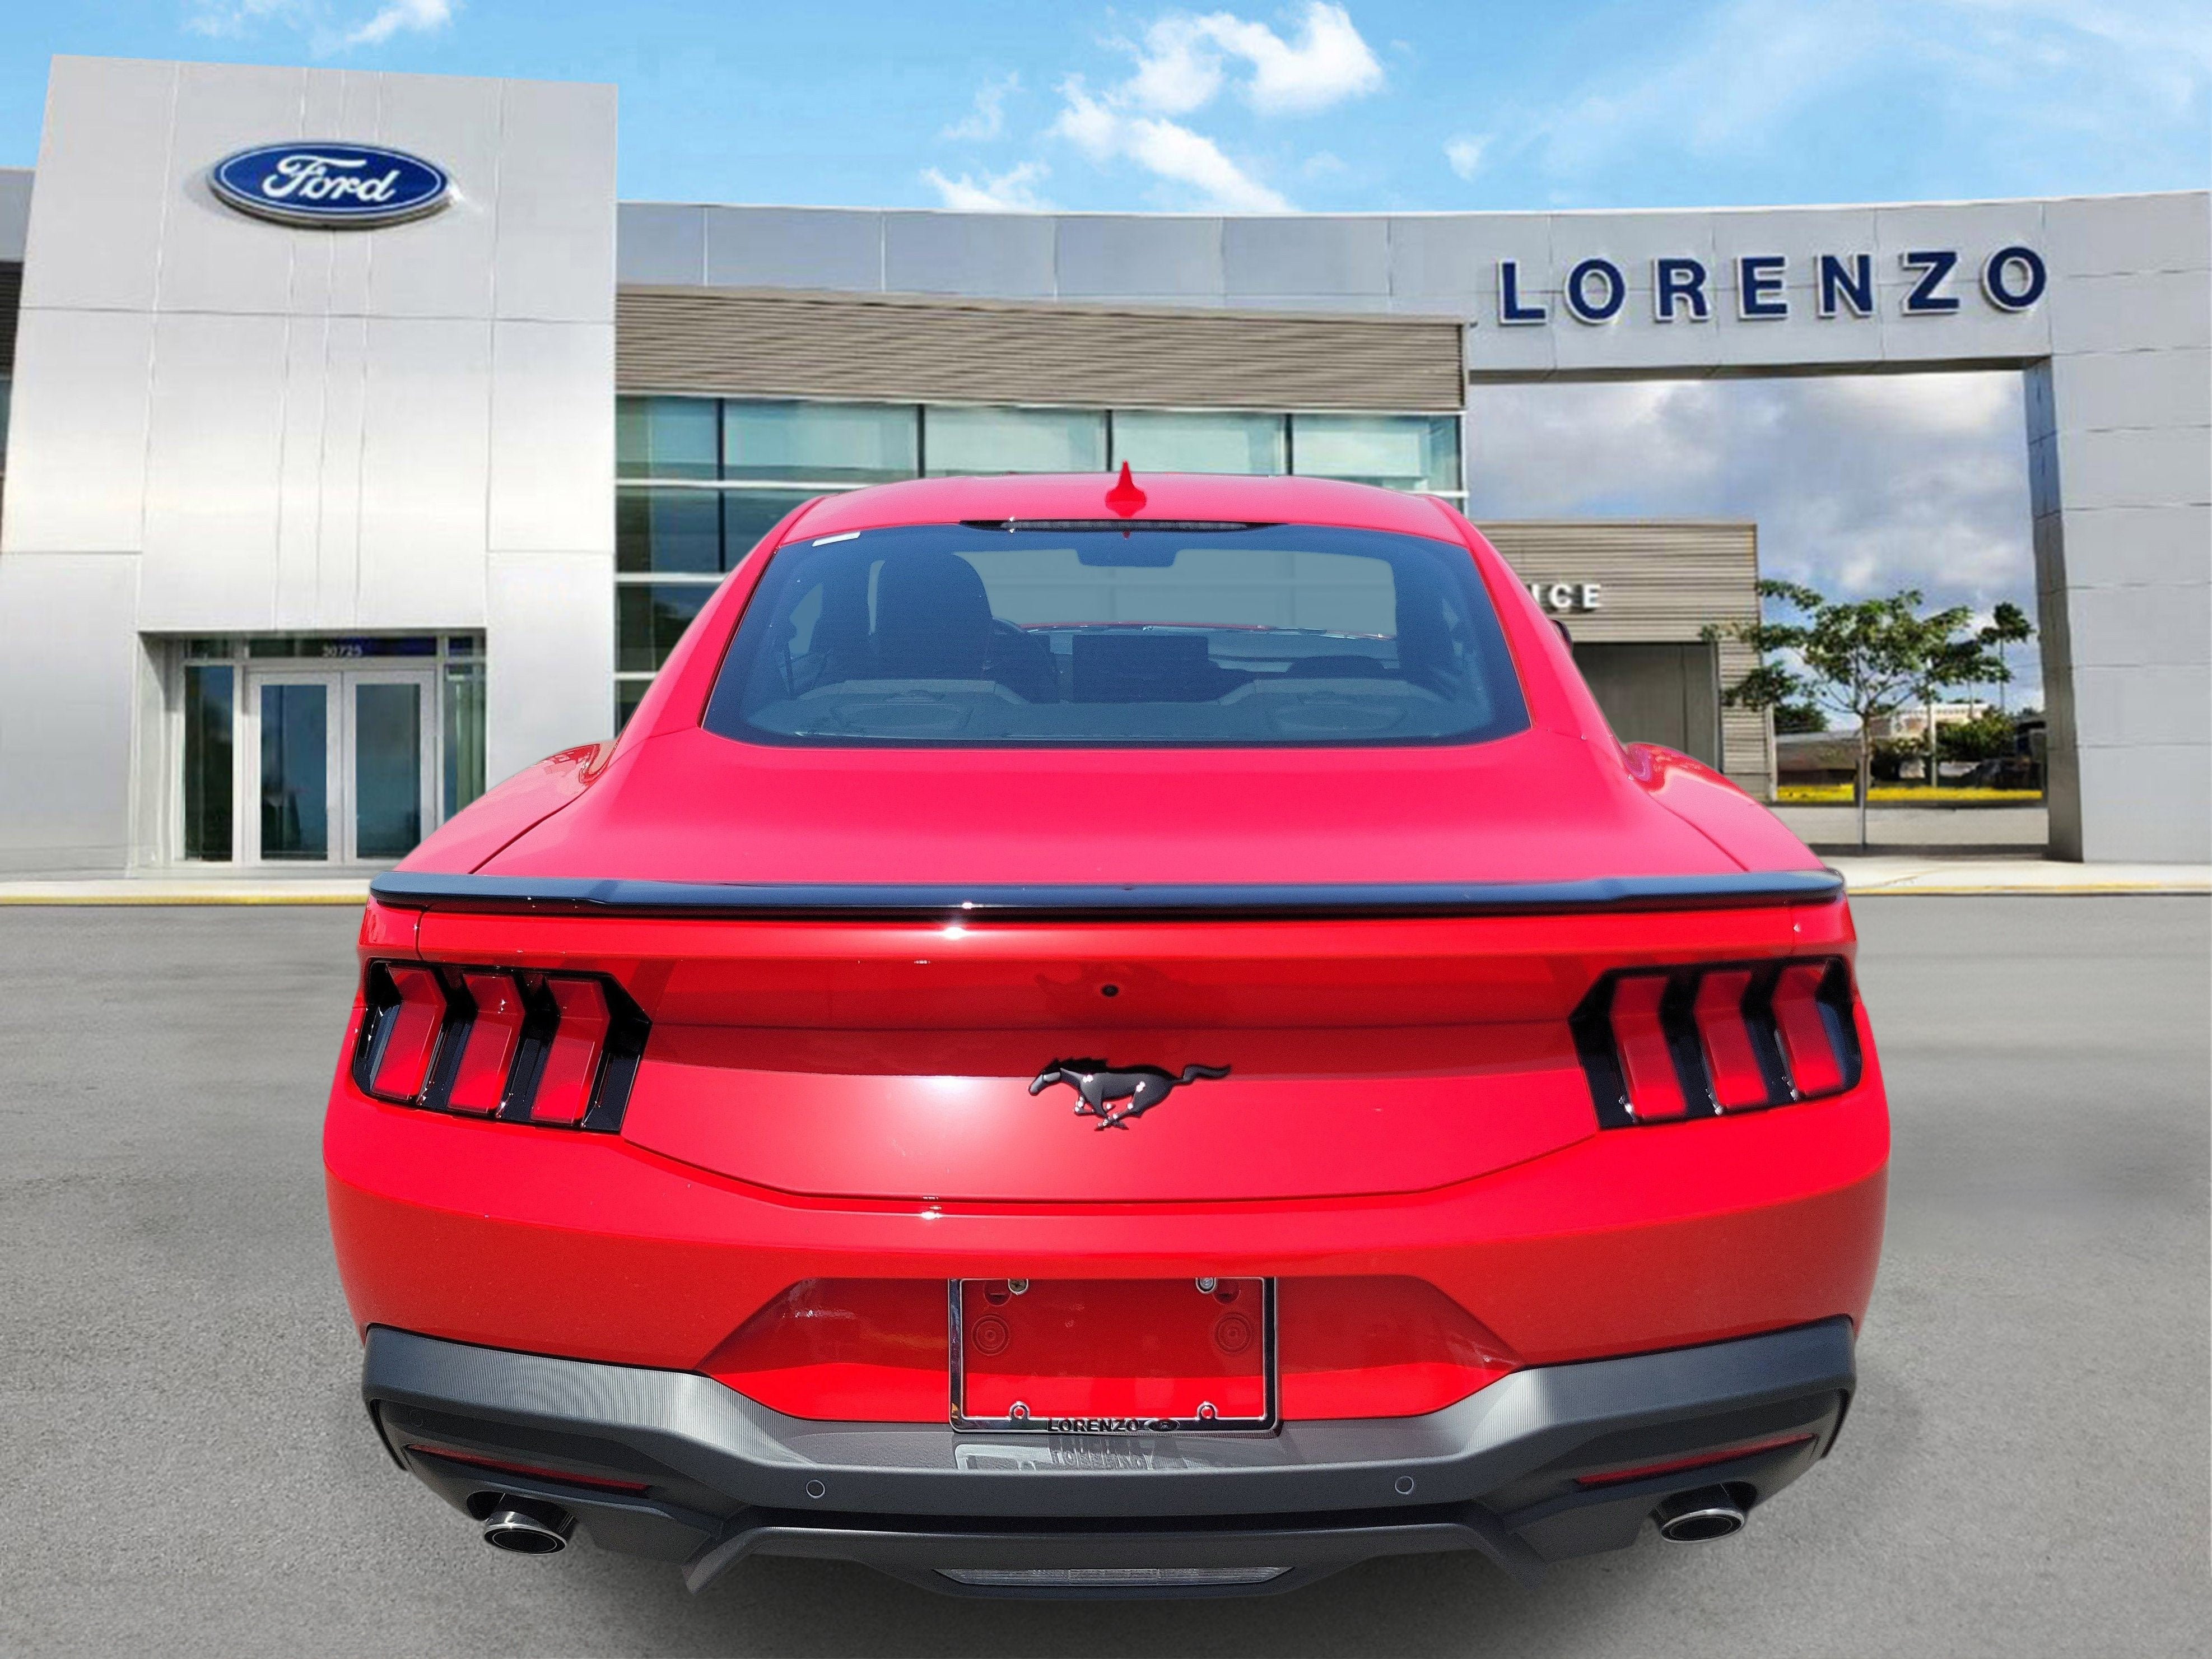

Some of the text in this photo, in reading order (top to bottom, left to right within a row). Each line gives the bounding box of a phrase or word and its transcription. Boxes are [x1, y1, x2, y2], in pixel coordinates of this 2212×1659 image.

[262, 154, 401, 202] Ford
[1497, 245, 2047, 325] LORENZO
[1046, 1418, 1139, 1433] LORENZO
